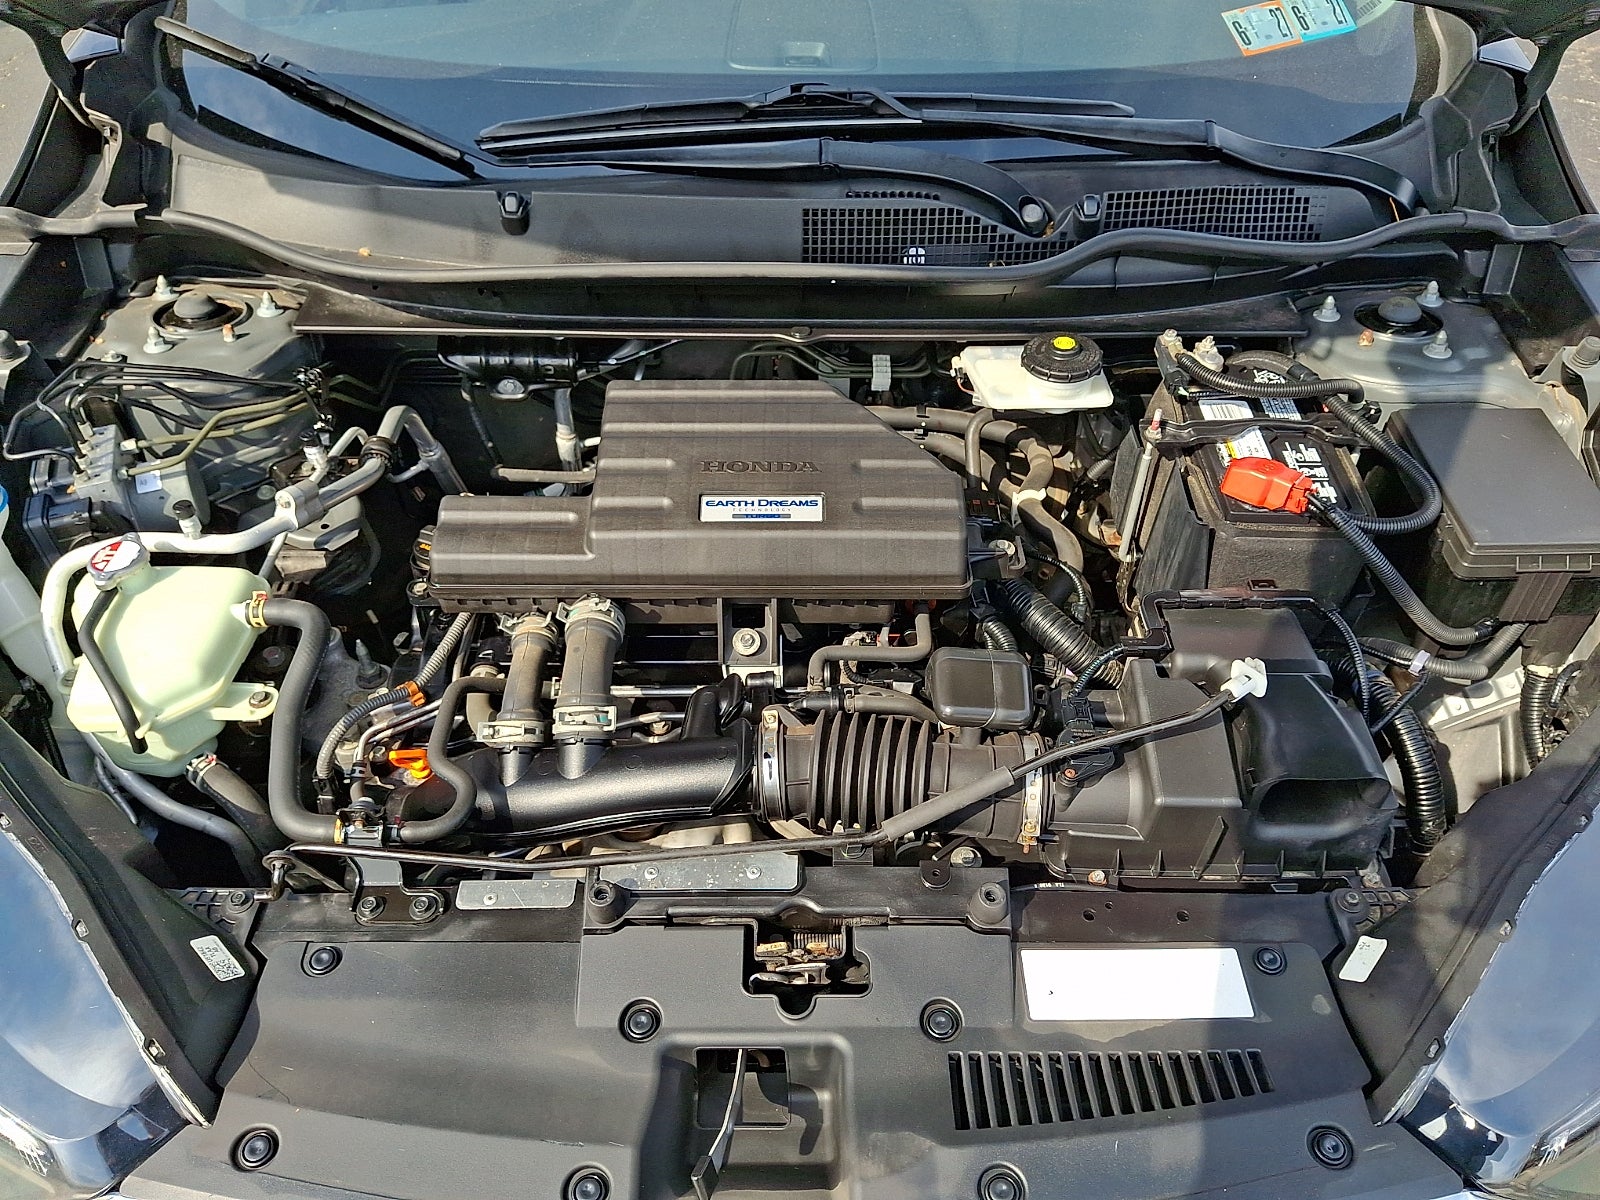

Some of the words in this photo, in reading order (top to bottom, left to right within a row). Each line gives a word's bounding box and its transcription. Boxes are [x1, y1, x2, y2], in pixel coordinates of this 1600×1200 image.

[1232, 20, 1252, 46] 6
[1268, 6, 1294, 39] 27
[1291, 5, 1310, 31] 6
[700, 460, 823, 474] HONDA
[757, 499, 819, 507] DREAMS
